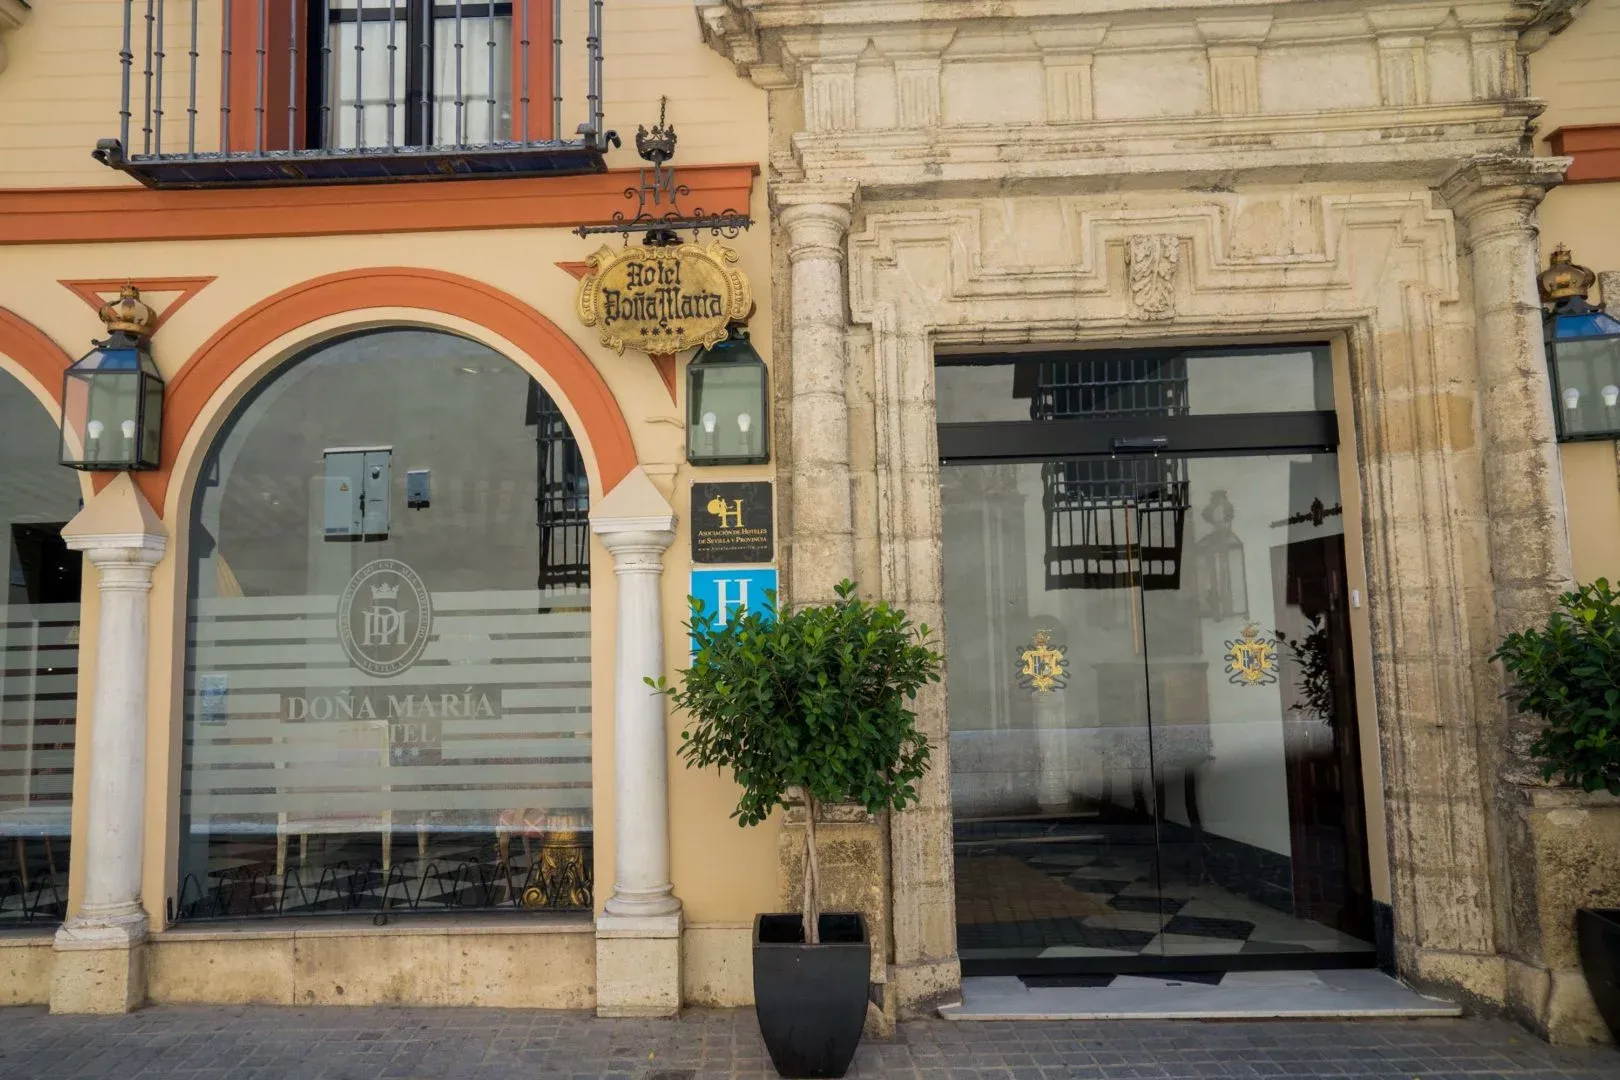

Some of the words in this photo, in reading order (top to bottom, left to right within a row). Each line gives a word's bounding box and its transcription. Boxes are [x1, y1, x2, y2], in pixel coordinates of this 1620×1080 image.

[627, 259, 681, 290] Hotel
[602, 287, 657, 326] Doña
[713, 579, 753, 626] H
[287, 689, 377, 720] DOÑA
[387, 686, 496, 719] MARÍA
